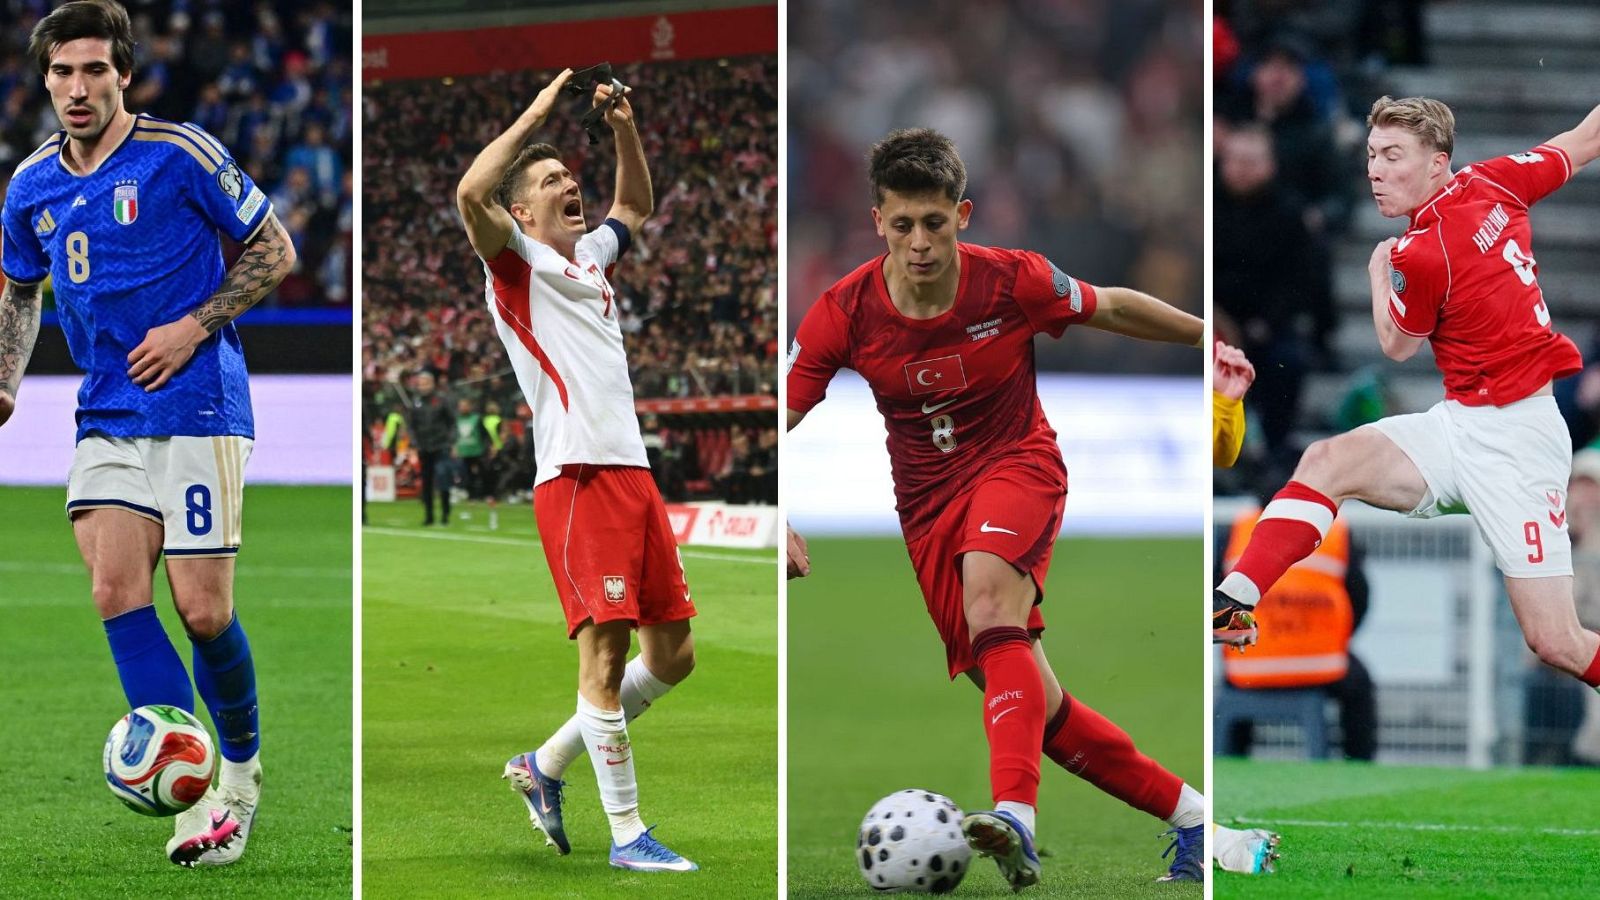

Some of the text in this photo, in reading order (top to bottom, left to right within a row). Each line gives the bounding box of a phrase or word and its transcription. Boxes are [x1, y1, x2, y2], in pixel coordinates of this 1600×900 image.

[1472, 202, 1510, 254] HØJLUND
[66, 231, 90, 284] 8
[1502, 238, 1551, 328] 9
[930, 414, 958, 453] 8
[185, 483, 213, 536] 8
[1523, 521, 1544, 564] 9
[988, 690, 1024, 710] TÜRKİYE
